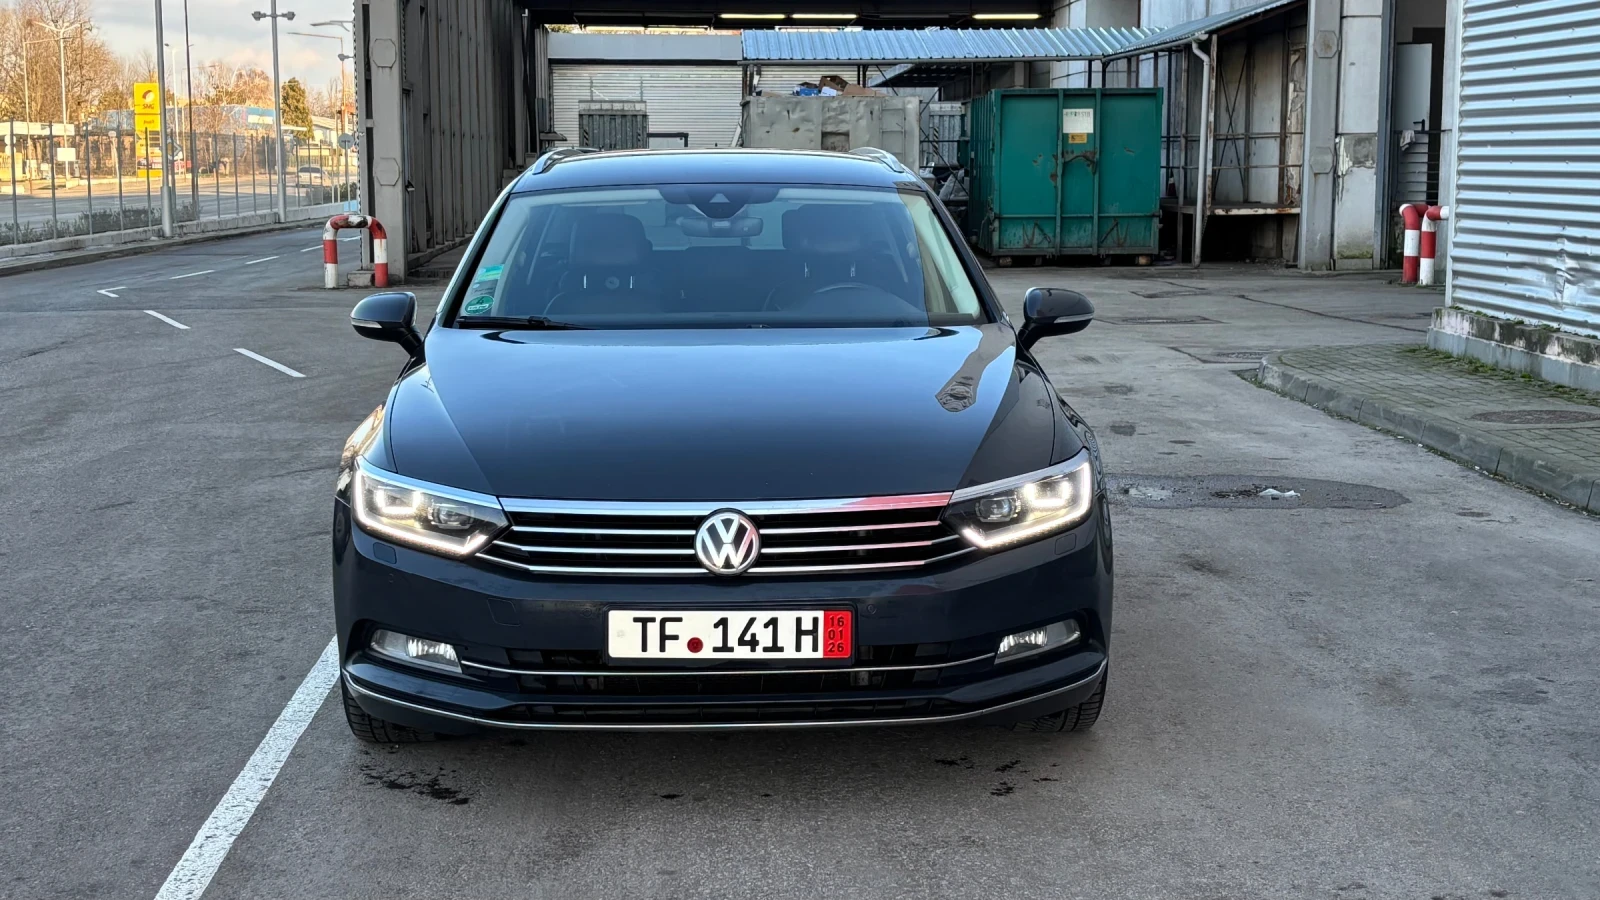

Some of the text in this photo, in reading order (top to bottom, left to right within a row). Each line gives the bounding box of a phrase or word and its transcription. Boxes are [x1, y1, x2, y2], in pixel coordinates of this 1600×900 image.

[697, 512, 758, 573] VW
[829, 614, 845, 627] 16
[633, 616, 819, 652] TF 141 H
[828, 628, 844, 641] 01
[827, 640, 845, 653] 26
